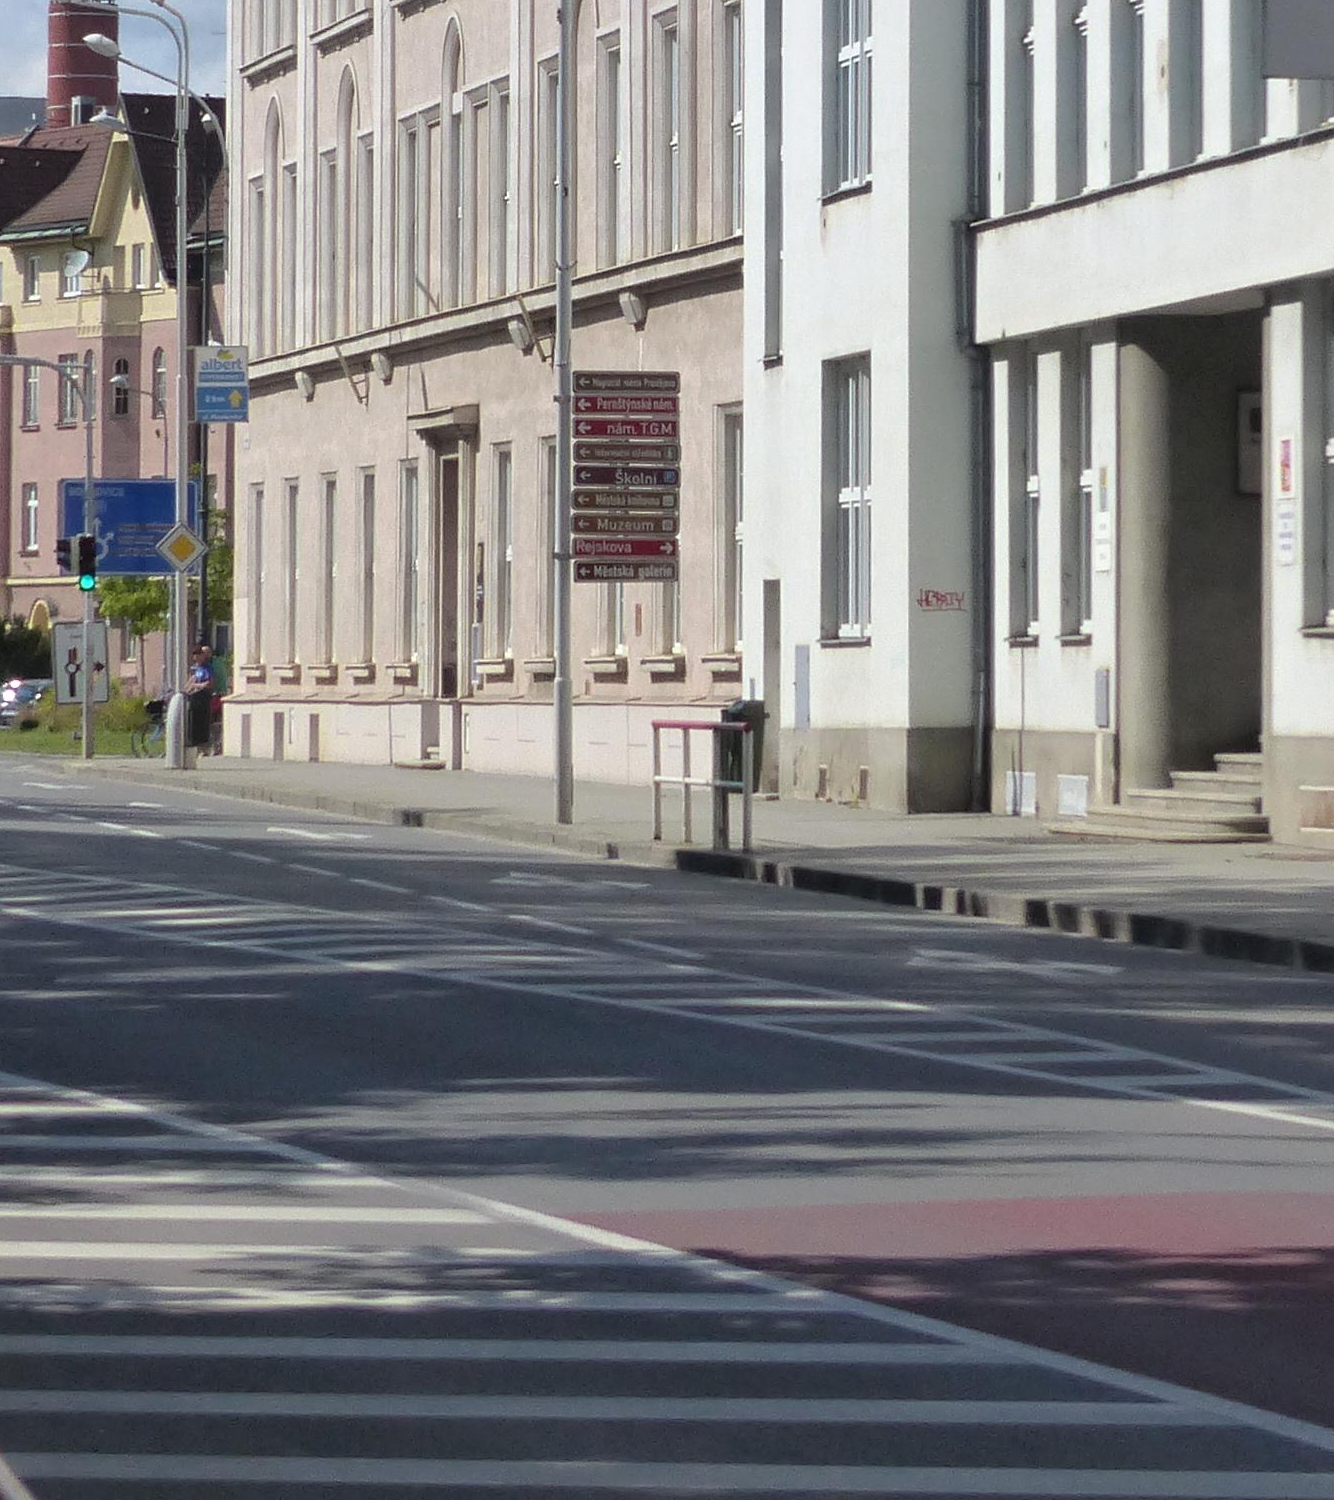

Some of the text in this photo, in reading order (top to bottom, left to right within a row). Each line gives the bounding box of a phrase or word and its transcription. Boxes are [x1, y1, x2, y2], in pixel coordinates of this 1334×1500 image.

[201, 359, 243, 370] albert
[653, 398, 675, 410] nám.
[607, 421, 675, 435] nám. T.G.M.
[615, 468, 658, 485] Školní
[597, 518, 654, 532] Muzeum
